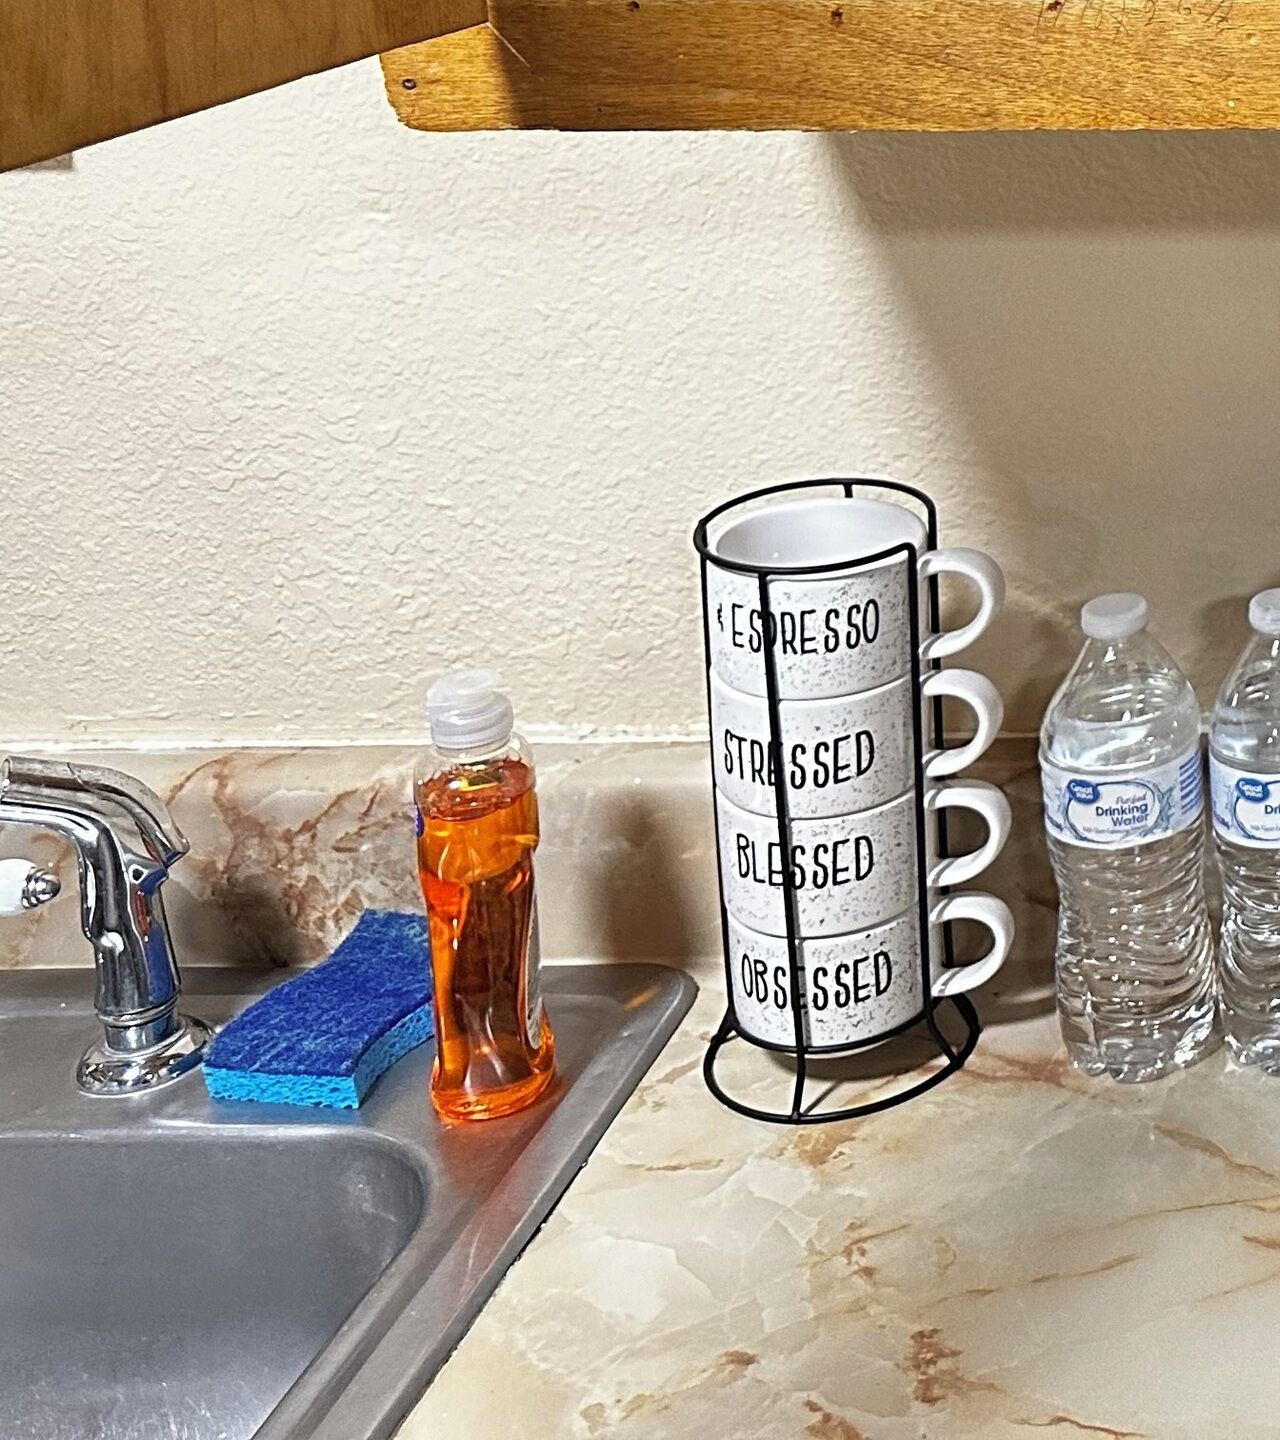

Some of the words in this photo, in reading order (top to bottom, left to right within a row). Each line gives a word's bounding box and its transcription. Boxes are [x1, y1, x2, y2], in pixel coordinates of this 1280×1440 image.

[1095, 802, 1149, 818] Drinking
[1111, 812, 1149, 827] Water
[736, 832, 875, 890] BLESSED
